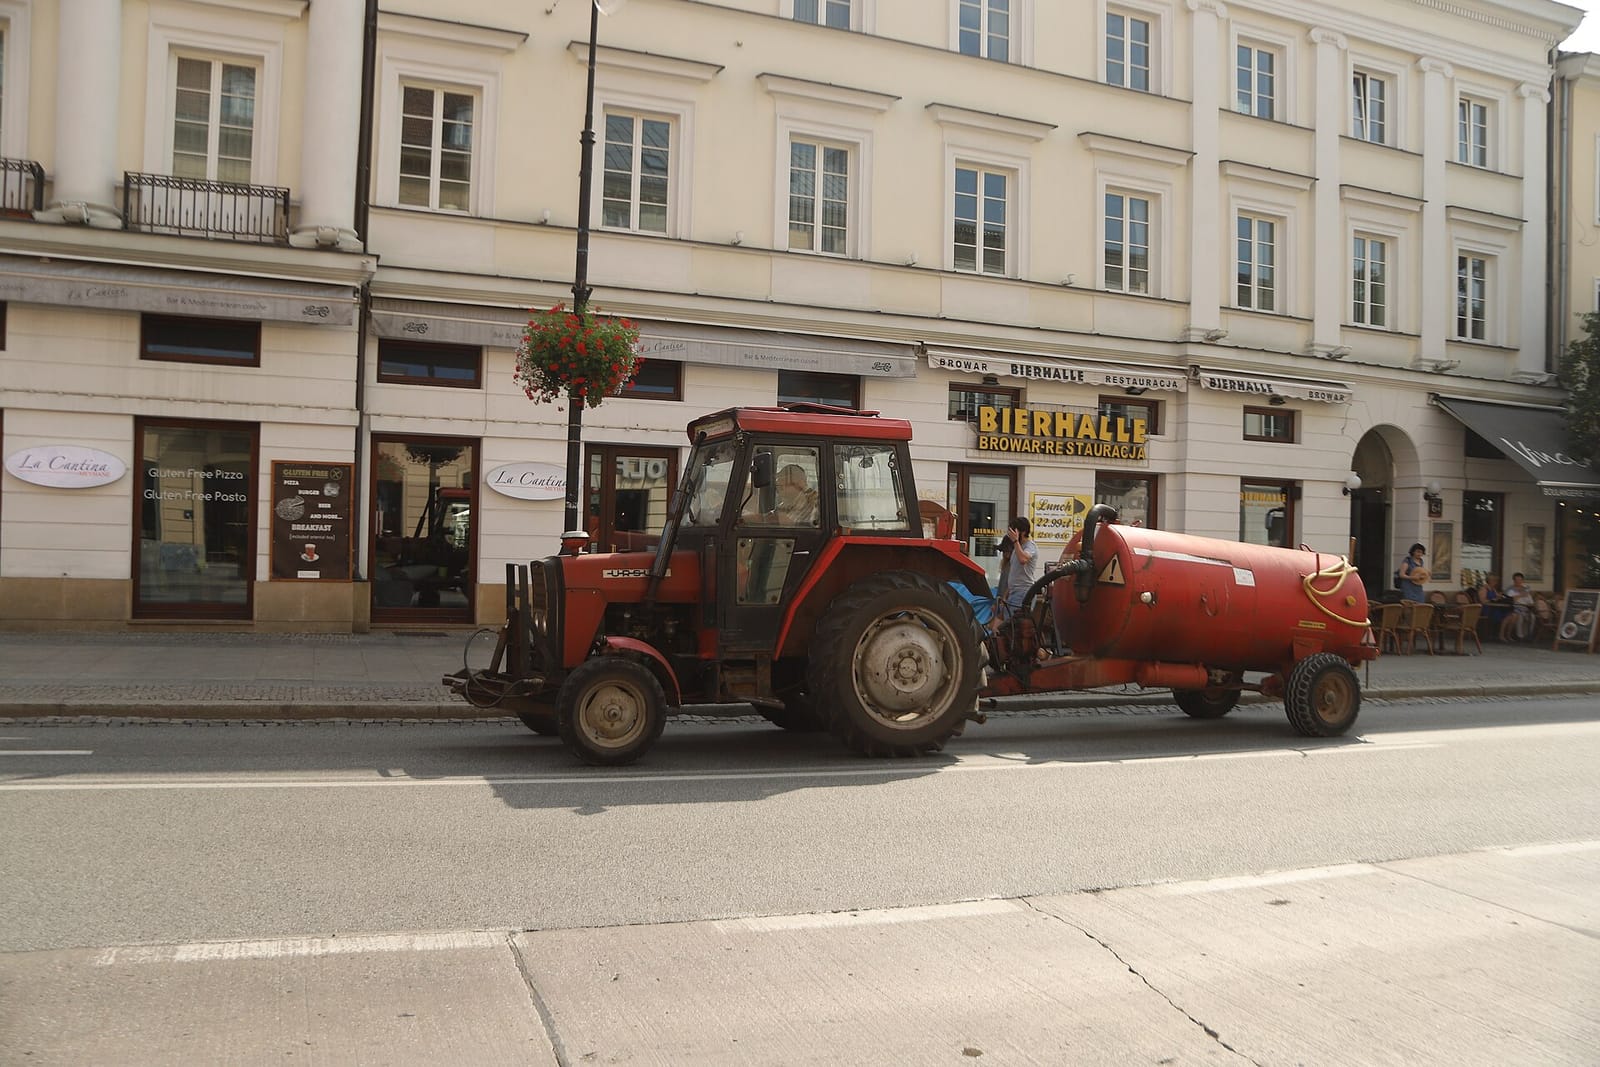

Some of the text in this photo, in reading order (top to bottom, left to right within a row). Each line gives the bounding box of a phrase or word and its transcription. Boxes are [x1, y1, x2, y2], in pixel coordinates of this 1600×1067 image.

[939, 357, 1178, 388] BROWAR BIERHALLE RESTAURACJA
[1209, 377, 1345, 401] BIERHALLE BROWAR
[978, 406, 1147, 444] BIERHALLE
[18, 454, 109, 471] La Cantina
[148, 467, 243, 480] Gluten Free Pizza
[282, 469, 329, 477] GLUTEN FREE
[495, 470, 514, 484] La
[143, 489, 247, 502] Gluten Free Pasta
[1036, 498, 1072, 512] Lunch
[291, 523, 333, 532] BREAKFAST
